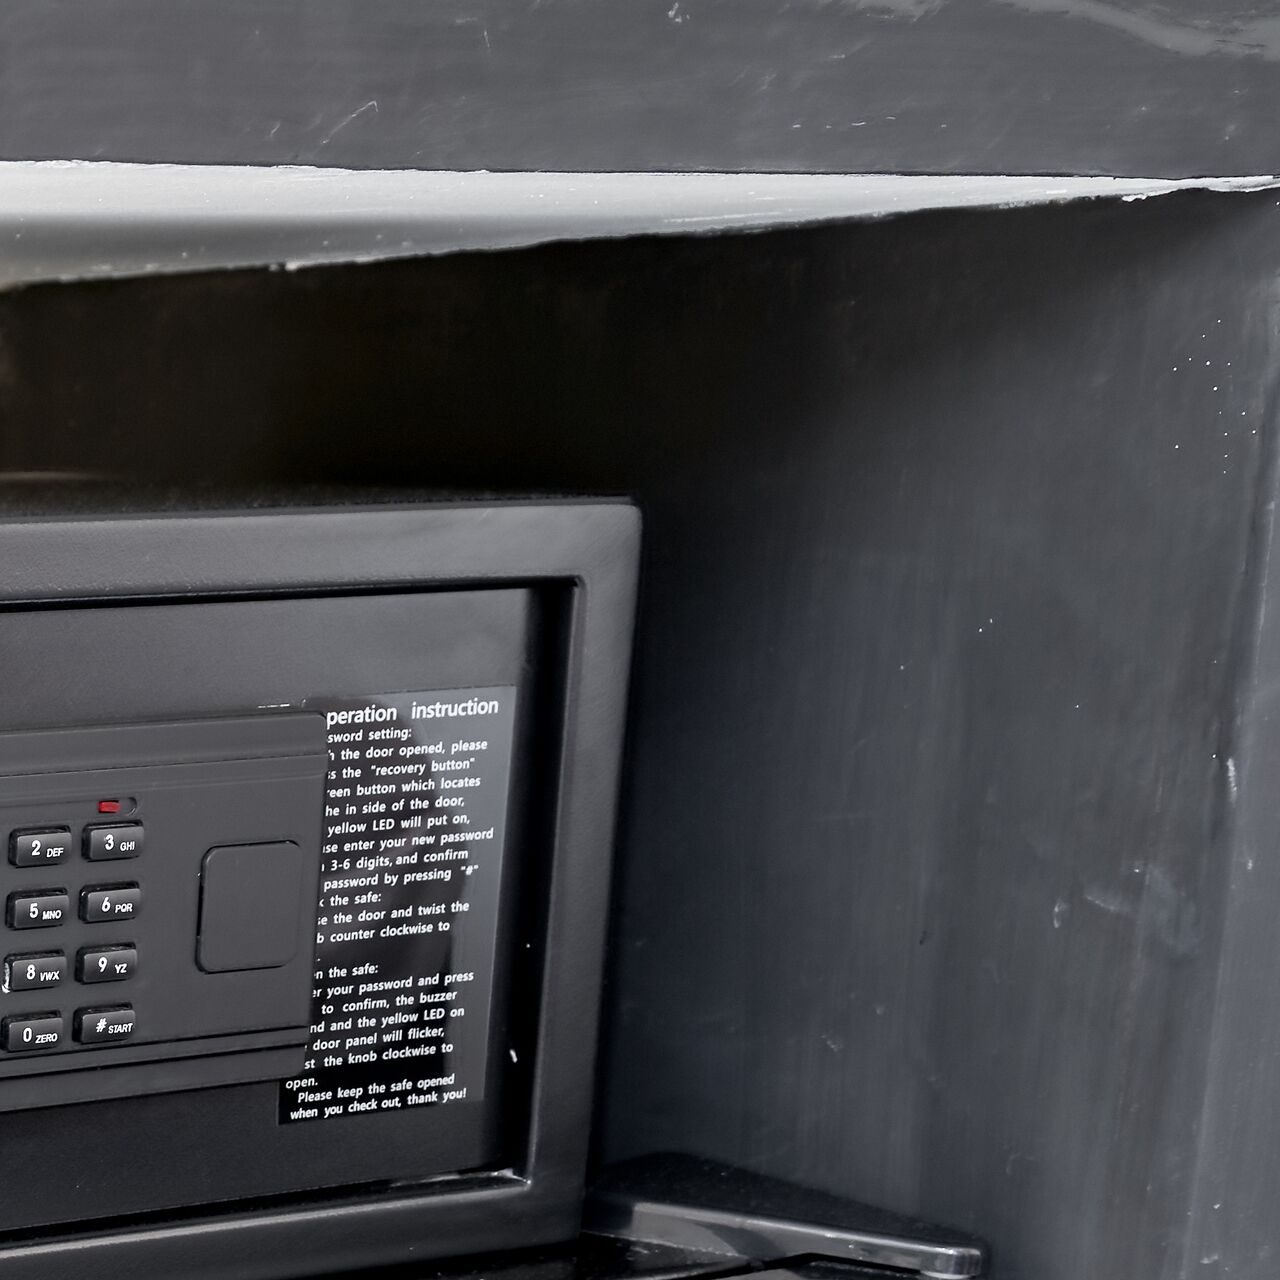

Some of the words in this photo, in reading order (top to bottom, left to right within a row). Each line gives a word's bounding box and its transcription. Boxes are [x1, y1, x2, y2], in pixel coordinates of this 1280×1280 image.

[327, 705, 397, 729] peration
[411, 697, 499, 719] instruction
[327, 729, 363, 743] sword
[368, 728, 412, 740] setting:
[341, 748, 360, 760] the
[366, 745, 394, 758] door
[399, 742, 446, 757] opened,
[451, 739, 488, 754] please
[342, 767, 362, 778] the
[371, 762, 426, 776] "recovery
[431, 756, 475, 772] button"
[327, 786, 350, 797] een
[356, 783, 396, 795] button
[401, 779, 435, 792] which
[441, 776, 481, 789] locates
[325, 805, 339, 817] he
[345, 802, 357, 815] in
[362, 800, 386, 813] side
[392, 799, 404, 810] of
[410, 799, 429, 810] the
[435, 795, 465, 808] door,
[327, 822, 366, 838] yellow
[373, 819, 395, 831] LED
[401, 816, 421, 828] will
[427, 815, 447, 828] put
[452, 814, 470, 825] on,
[31, 840, 41, 856] 2
[46, 847, 64, 858] DEF
[104, 834, 114, 850] 3
[120, 841, 135, 852] GHI
[344, 839, 375, 853] enter
[379, 835, 406, 852] your
[411, 833, 435, 845] new
[441, 828, 494, 849] password
[330, 859, 350, 871] 3-6
[356, 855, 393, 871] digits,
[396, 851, 418, 864] and
[423, 849, 469, 862] confirm
[323, 873, 378, 892] password
[384, 872, 399, 885] by
[403, 868, 452, 884] pressing
[101, 897, 111, 912] 6
[115, 903, 133, 913] PQR
[330, 895, 349, 907] the
[354, 892, 382, 905] safe:
[29, 903, 38, 919] 5
[42, 910, 62, 920] MNO
[334, 913, 353, 925] the
[358, 909, 386, 922] door
[391, 905, 412, 918] and
[418, 902, 446, 916] twist
[451, 900, 469, 912] the
[330, 929, 375, 942] counter
[380, 922, 433, 937] clockwise
[438, 921, 450, 931] to
[26, 965, 36, 980] 8
[40, 971, 60, 981] VWX
[98, 957, 108, 973] 9
[114, 963, 127, 974] YZ
[328, 967, 347, 978] the
[352, 963, 378, 976] safe:
[327, 984, 354, 999] your
[359, 976, 413, 994] password
[418, 974, 440, 987] and
[444, 972, 474, 985] press
[321, 1003, 334, 1015] to
[342, 1000, 390, 1013] confirm,
[395, 995, 415, 1006] the
[419, 991, 457, 1004] buzzer
[108, 1023, 133, 1034] START
[330, 1019, 352, 1031] and
[357, 1017, 377, 1027] the
[381, 1012, 418, 1027] yellow
[424, 1008, 445, 1020] LED
[450, 1008, 465, 1017] on
[23, 1028, 32, 1043] 0
[35, 1033, 58, 1044] ZERO
[313, 1038, 340, 1051] door
[345, 1033, 377, 1049] panel
[382, 1031, 402, 1042] will
[408, 1028, 445, 1040] flicker,
[324, 1055, 343, 1067] the
[348, 1052, 377, 1064] knob
[382, 1045, 436, 1059] clockwise
[441, 1043, 454, 1053] to
[285, 1077, 318, 1091] open.
[298, 1091, 332, 1103] Please
[337, 1087, 363, 1098] keep
[368, 1083, 386, 1094] the
[390, 1080, 412, 1092] safe
[417, 1074, 455, 1089] opened
[290, 1108, 318, 1120] when
[324, 1105, 343, 1119] you
[348, 1101, 377, 1112] check
[381, 1097, 402, 1108] out,
[407, 1091, 438, 1105] thank
[443, 1088, 466, 1103] you!
